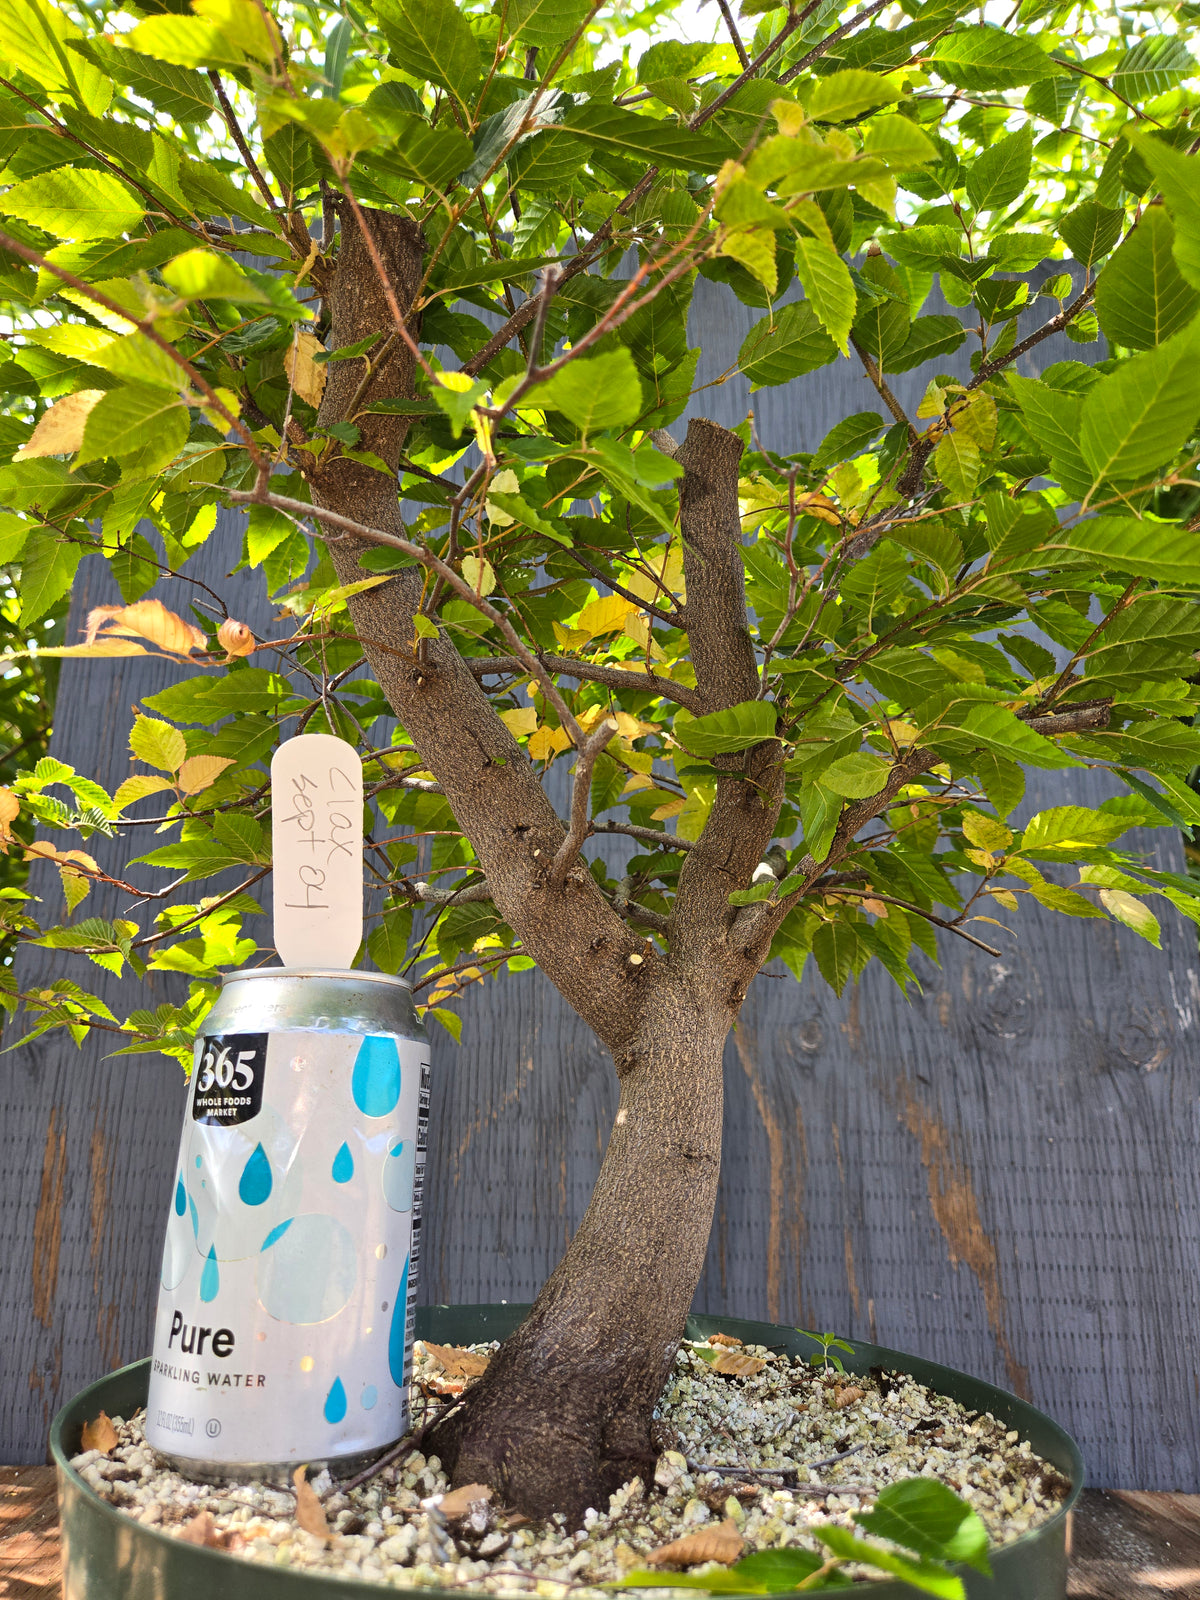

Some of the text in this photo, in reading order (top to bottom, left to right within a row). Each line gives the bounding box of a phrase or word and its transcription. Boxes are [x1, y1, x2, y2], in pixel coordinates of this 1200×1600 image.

[198, 1047, 256, 1092] 365
[196, 1097, 252, 1107] WHOLE FOODS
[206, 1108, 238, 1117] MARKET
[168, 1309, 235, 1358] Pure
[153, 1359, 267, 1388] SPARKLING WATER
